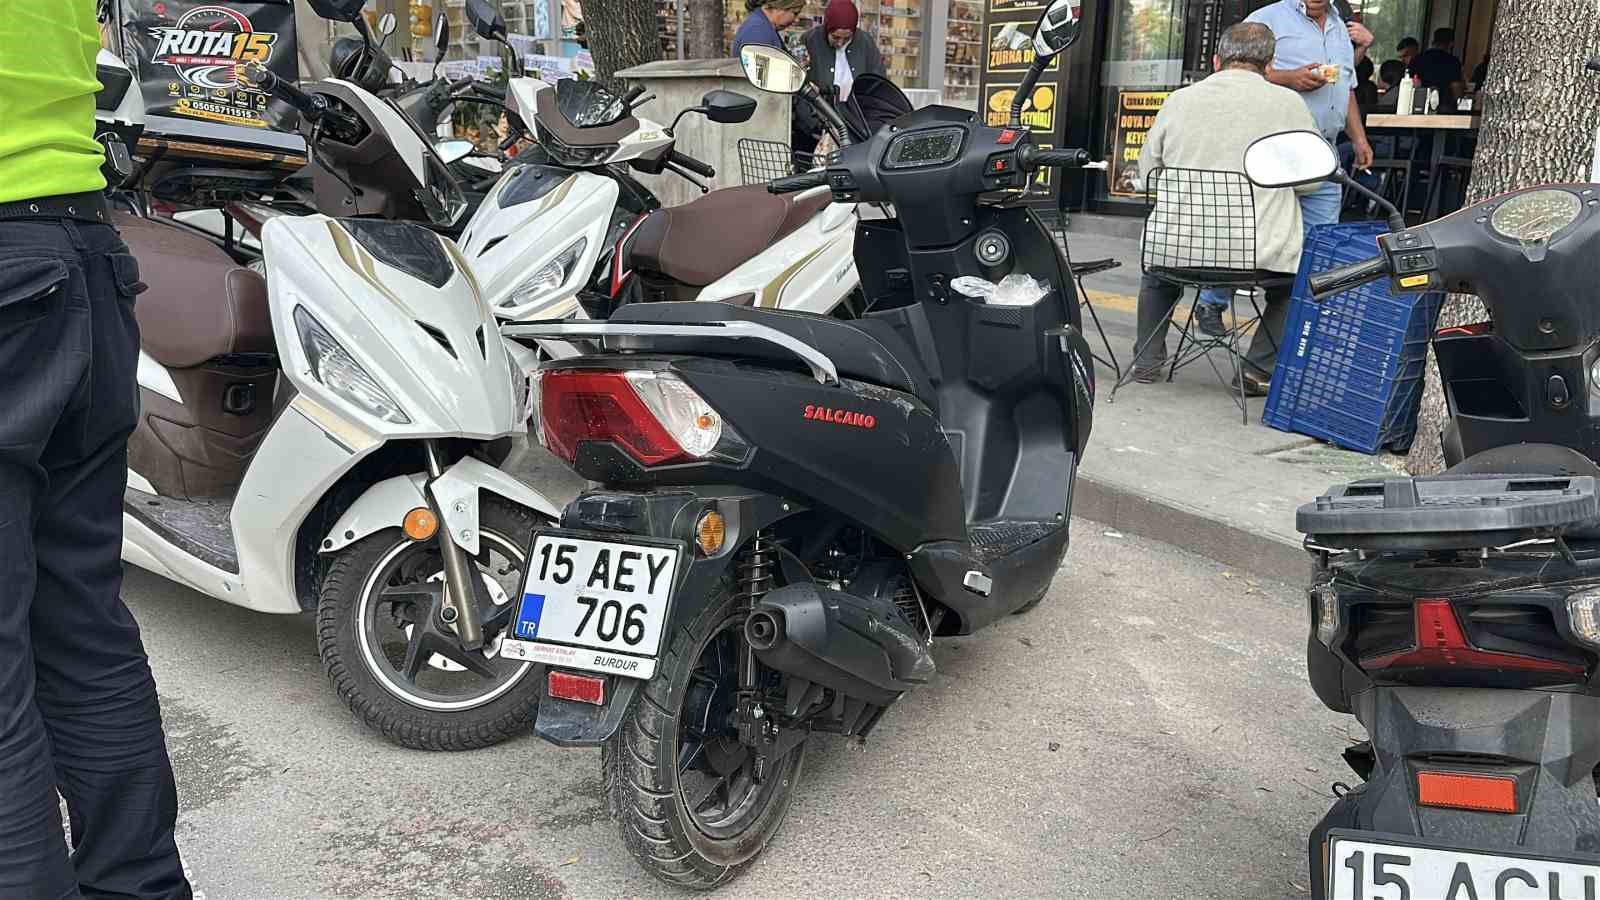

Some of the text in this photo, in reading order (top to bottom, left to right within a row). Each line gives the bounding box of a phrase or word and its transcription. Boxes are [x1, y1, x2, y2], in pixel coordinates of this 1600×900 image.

[804, 404, 876, 429] SALCANO
[539, 543, 669, 595] 15 AEY
[521, 620, 536, 634] TR
[574, 596, 648, 645] 706
[594, 655, 639, 671] BURDUR
[1345, 851, 1411, 900] 15
